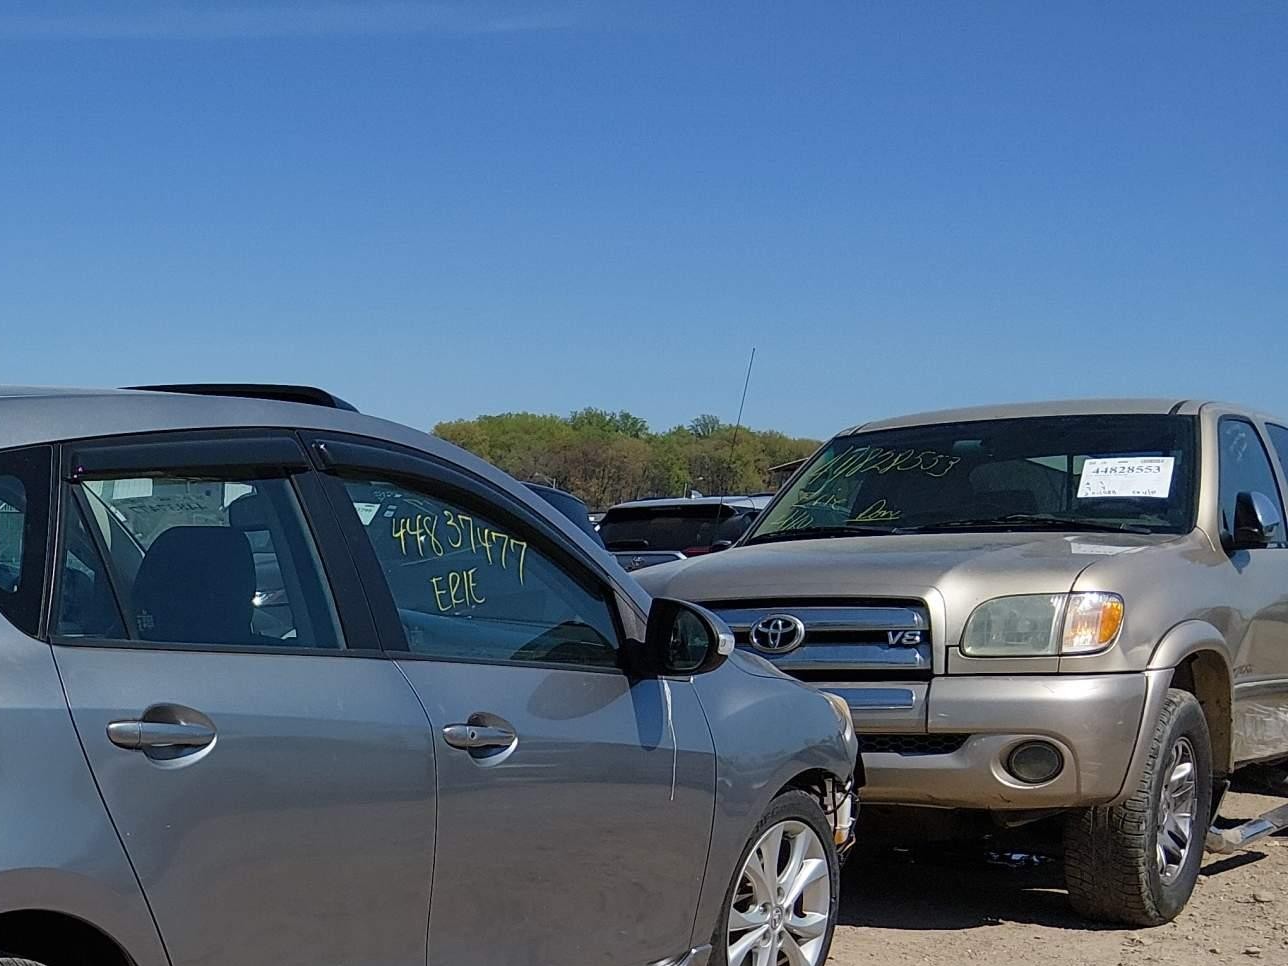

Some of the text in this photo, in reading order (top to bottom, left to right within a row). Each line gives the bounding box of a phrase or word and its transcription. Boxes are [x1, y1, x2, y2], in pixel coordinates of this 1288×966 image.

[1092, 465, 1161, 475] 44828553
[392, 510, 527, 585] 44837477
[430, 568, 486, 612] ERIE
[887, 630, 921, 646] V8
